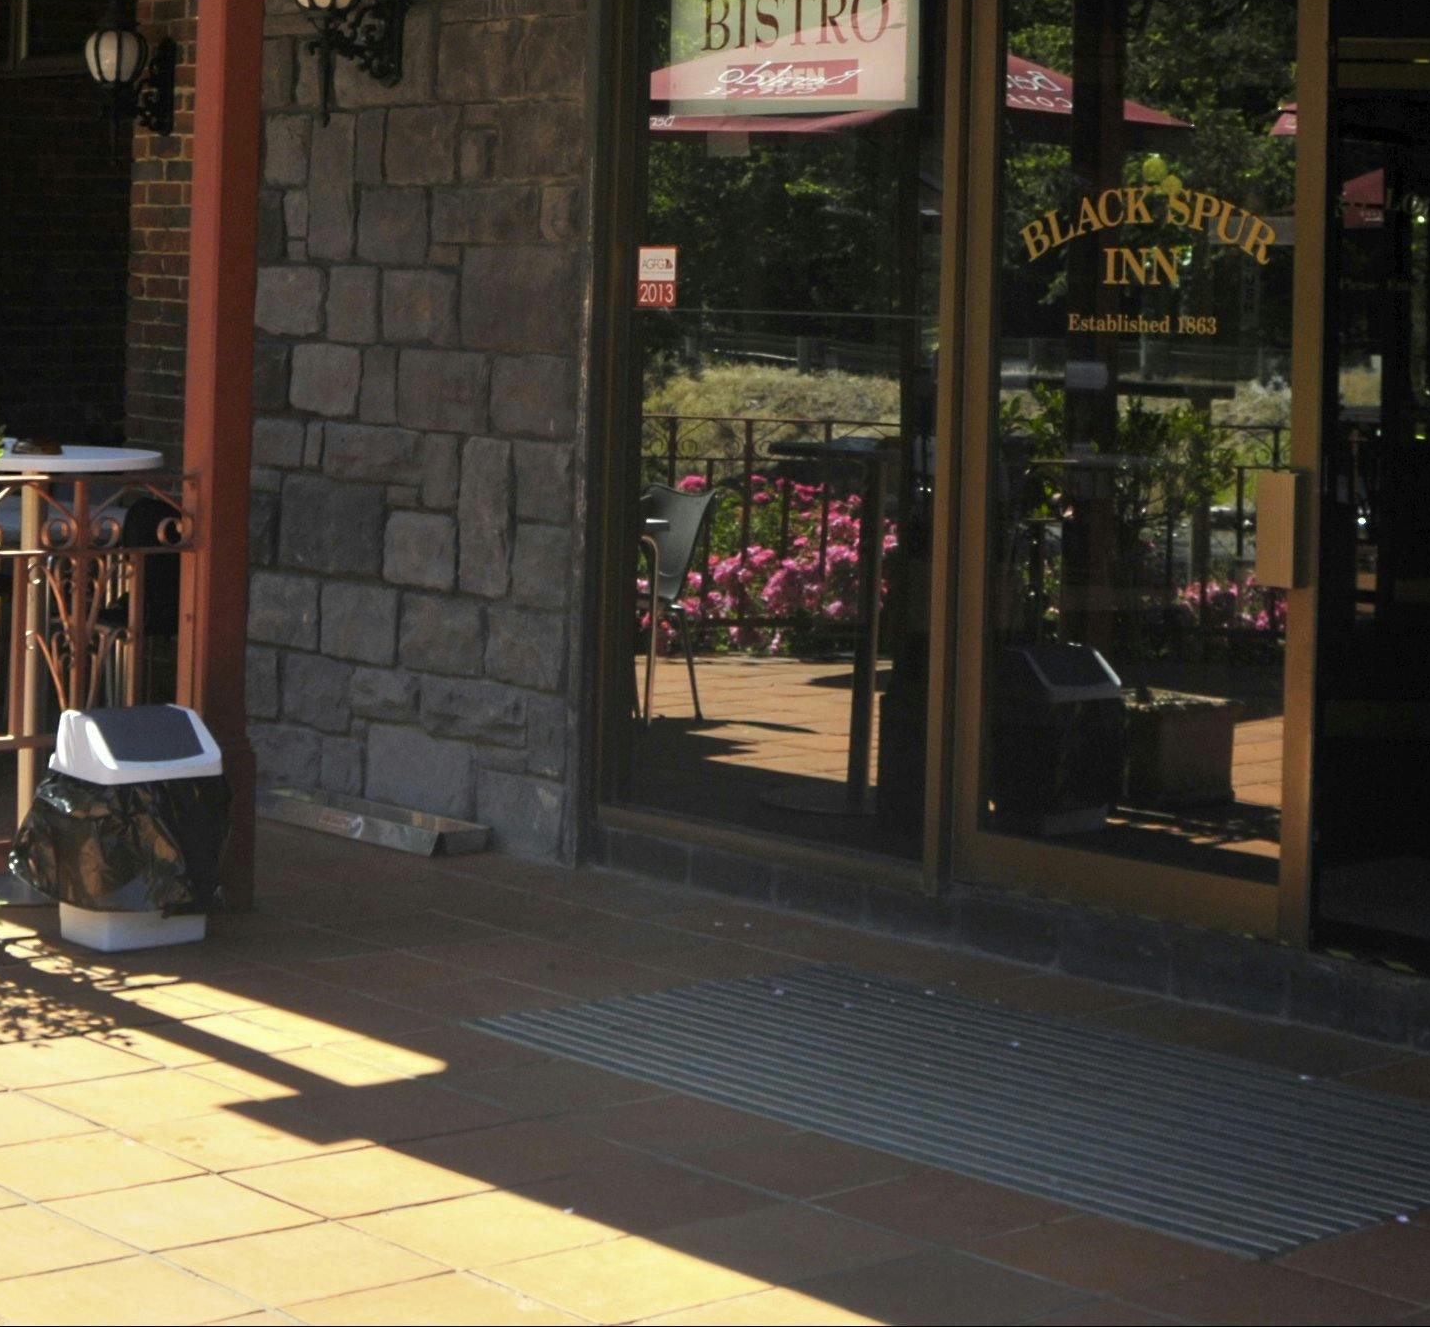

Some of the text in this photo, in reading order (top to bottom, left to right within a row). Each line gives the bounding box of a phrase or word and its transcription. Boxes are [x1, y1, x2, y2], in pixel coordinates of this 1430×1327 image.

[1019, 185, 1277, 266] BLACK SPUR
[1102, 246, 1183, 286] INN
[639, 283, 674, 303] 2013
[1067, 314, 1218, 336] Established 1863
